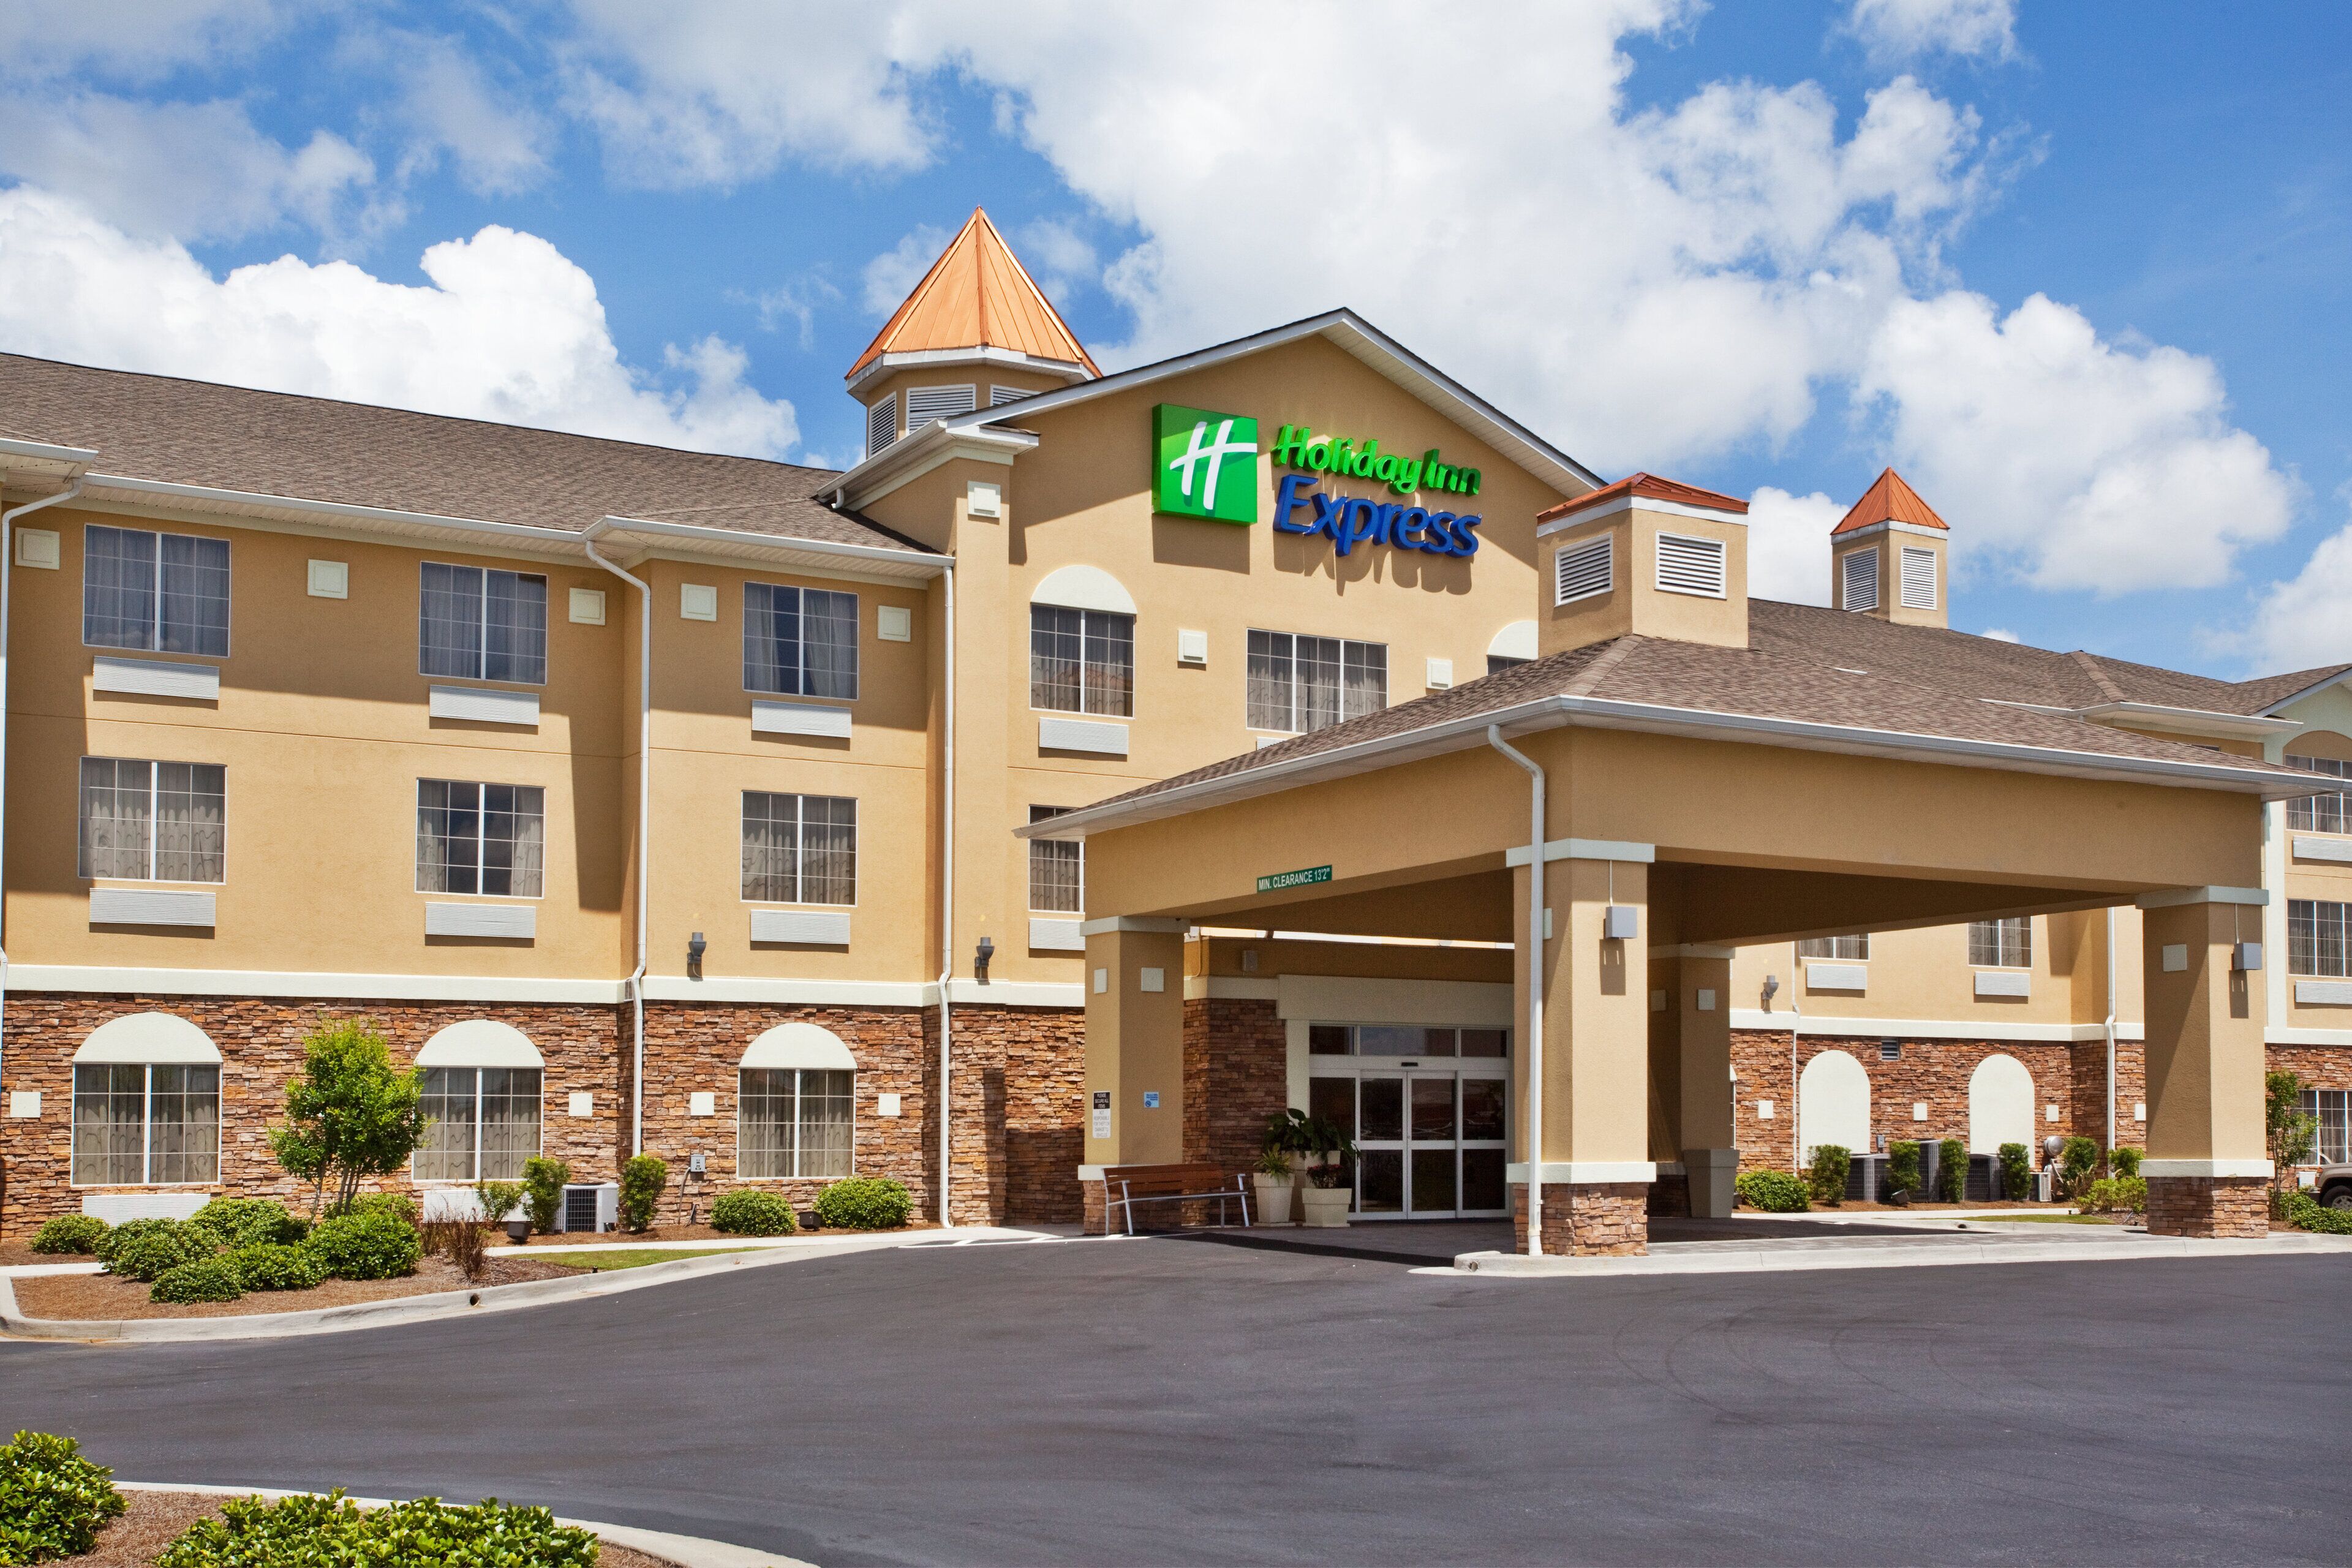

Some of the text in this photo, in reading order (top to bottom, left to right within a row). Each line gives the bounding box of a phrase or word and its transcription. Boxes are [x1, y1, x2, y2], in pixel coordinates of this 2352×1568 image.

[1272, 424, 1481, 496] Holiday Inn
[1273, 474, 1482, 557] Express
[1259, 878, 1272, 891] MIN.
[1273, 870, 1313, 888] CLEARANCE
